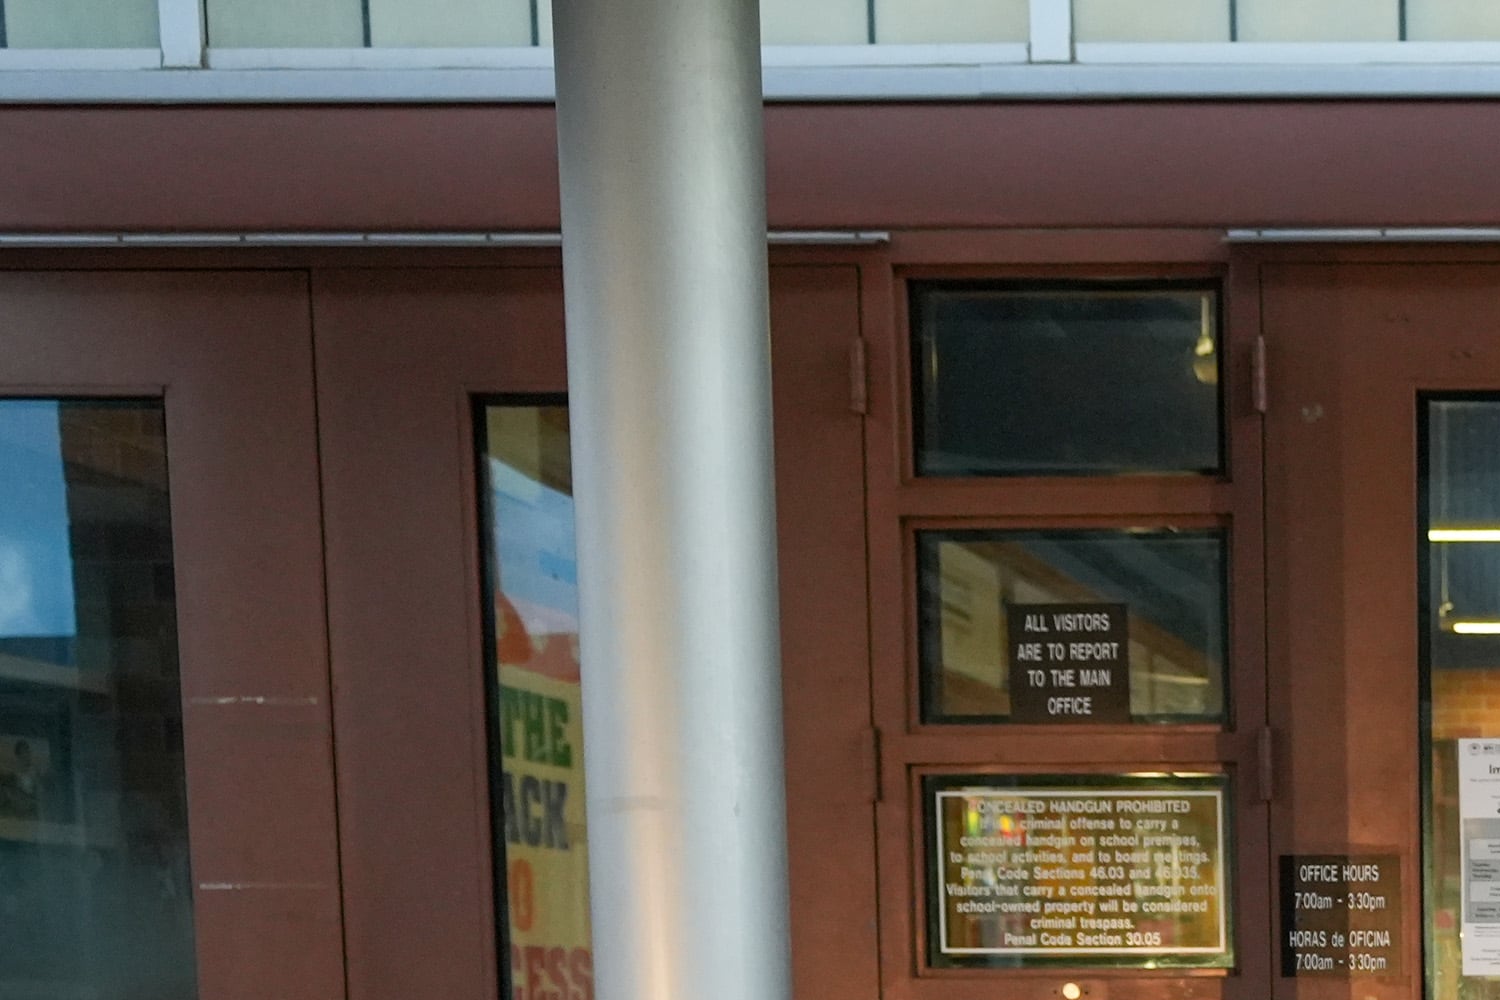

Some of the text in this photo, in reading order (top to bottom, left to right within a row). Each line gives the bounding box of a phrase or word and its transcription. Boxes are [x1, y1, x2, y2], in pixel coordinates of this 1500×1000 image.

[1024, 614, 1110, 632] ALL VISITORS
[1017, 643, 1119, 660] ARE TO REPORT
[1028, 670, 1110, 687] TO THE MAIN
[1048, 697, 1092, 714] OFFICE
[500, 686, 572, 766] THE
[1050, 800, 1111, 812] HANDGUN
[1116, 800, 1190, 812] PROHIBITED
[1020, 817, 1064, 830] criminal
[1070, 817, 1114, 830] offense
[1120, 818, 1132, 830] to
[1136, 819, 1167, 832] carry
[1172, 820, 1179, 830] a
[1026, 834, 1076, 849] handgun
[1080, 837, 1094, 846] on
[1100, 834, 1139, 846] school
[950, 851, 962, 862] to
[1072, 851, 1094, 862] and
[1098, 851, 1110, 862] to
[1115, 851, 1149, 862] board
[997, 867, 1028, 879] Code
[1034, 867, 1085, 879] Sections
[1090, 867, 1124, 879] 46.03
[1129, 867, 1151, 879] and
[1300, 865, 1380, 882] OFFICE HOURS
[946, 884, 1216, 898] Visitors that carry a concealed handgun onto
[956, 900, 1208, 914] school-owned property will be considered
[1030, 916, 1135, 930] criminal trespass.
[1004, 932, 1162, 945] Penal Code Section 30.05
[1290, 931, 1390, 948] HORAS de OFICINA
